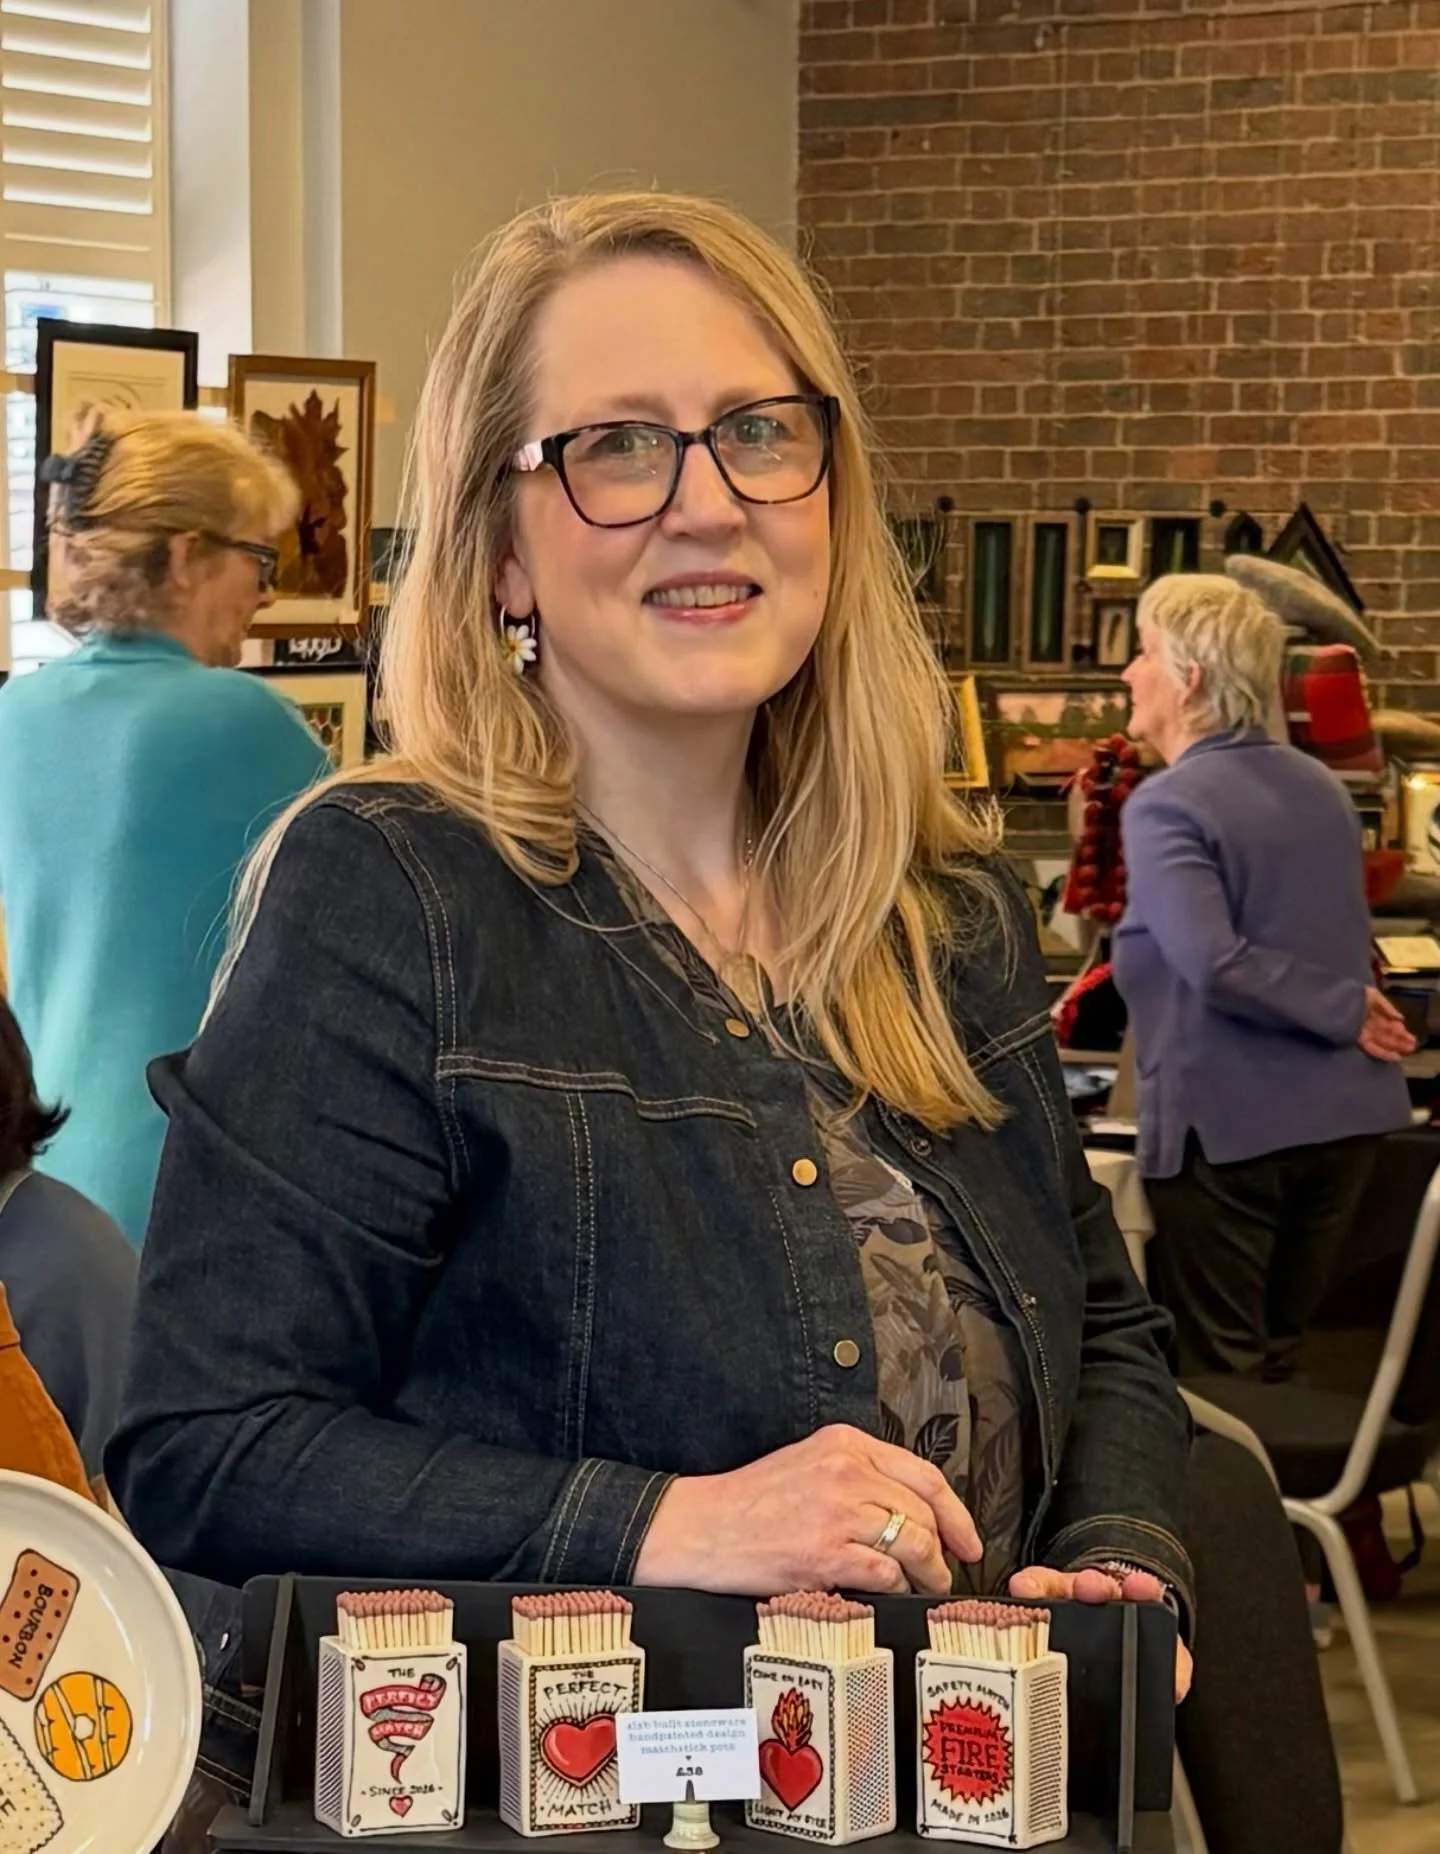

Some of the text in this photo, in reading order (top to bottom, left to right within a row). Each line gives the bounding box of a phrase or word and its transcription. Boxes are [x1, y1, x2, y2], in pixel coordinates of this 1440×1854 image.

[8, 1583, 54, 1669] BOURBON
[387, 1667, 416, 1678] THE
[543, 1681, 628, 1700] PERFECT
[927, 1680, 972, 1698] SAFETY
[628, 1728, 745, 1741] handpainted design
[941, 1736, 1001, 1769] FIRE
[369, 1785, 405, 1797] SINCE
[547, 1798, 612, 1817] MATCH
[931, 1799, 964, 1822] MADE
